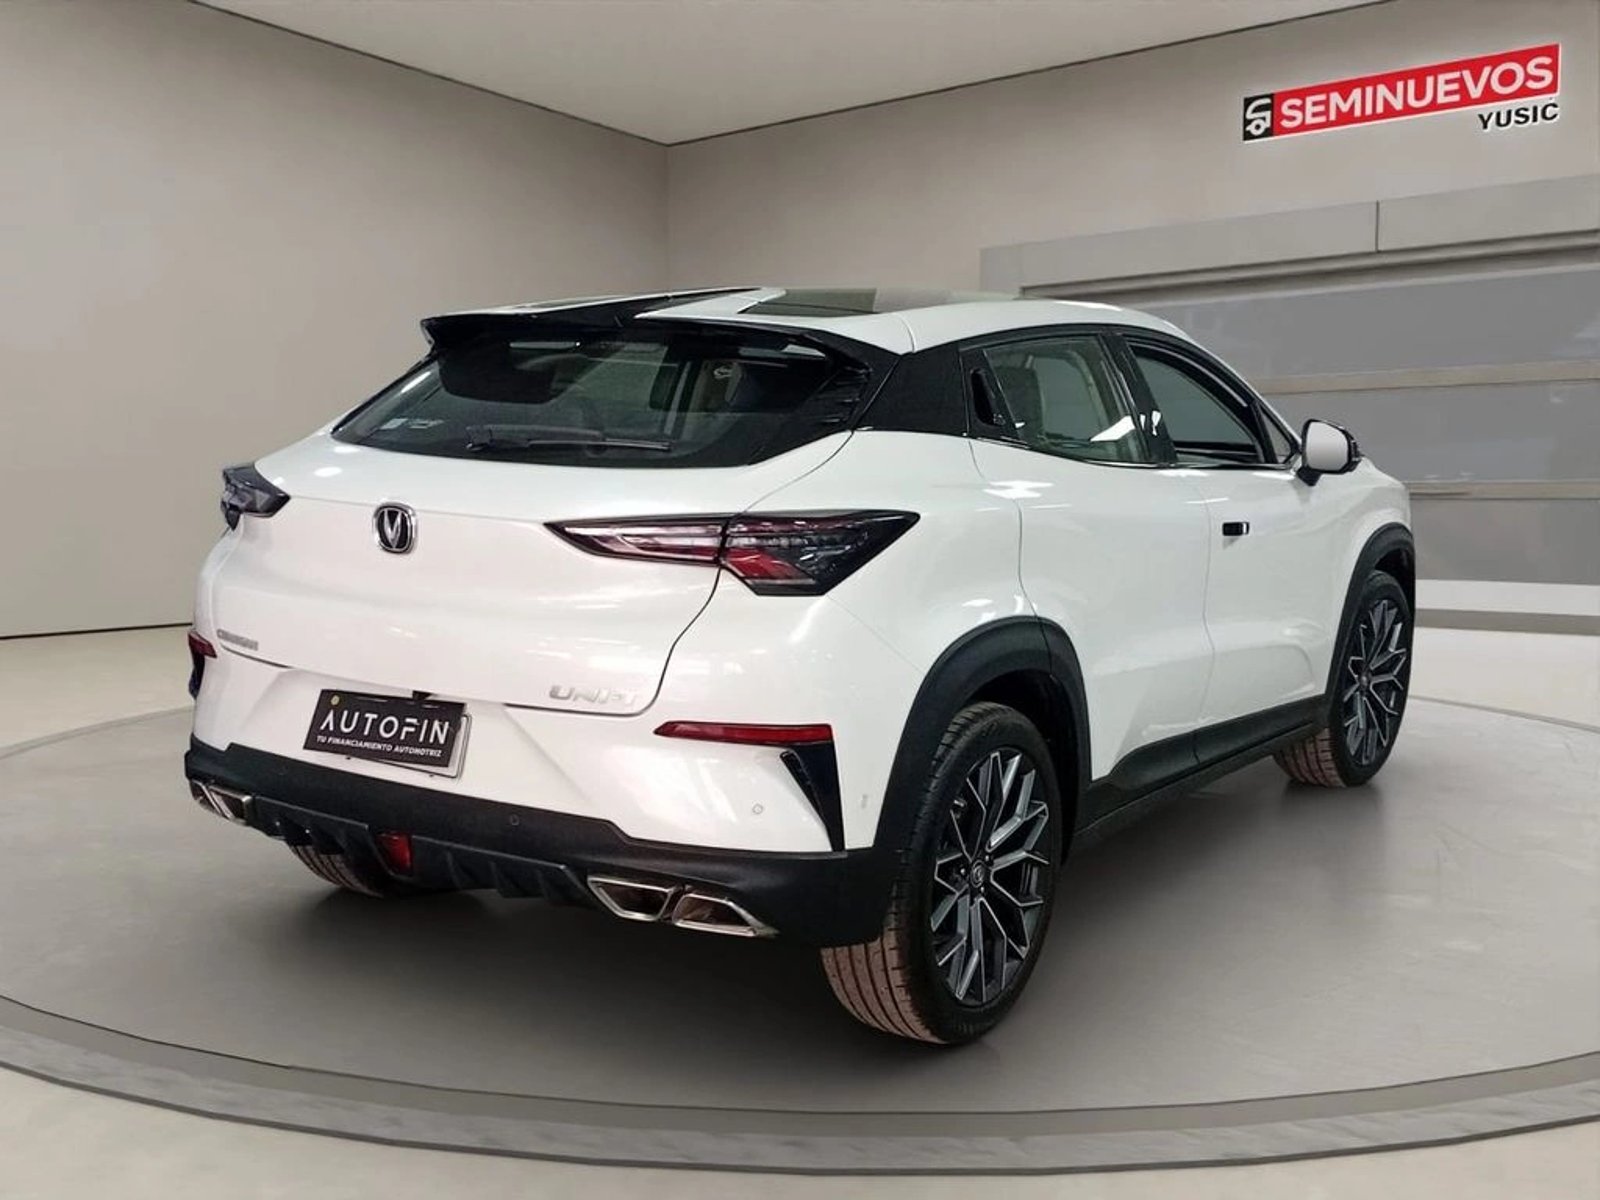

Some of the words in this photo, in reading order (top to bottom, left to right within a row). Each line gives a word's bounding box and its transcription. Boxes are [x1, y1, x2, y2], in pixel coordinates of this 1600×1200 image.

[1280, 56, 1553, 128] SEMINUEVOS
[320, 709, 450, 745] AUTOFIN
[316, 735, 328, 744] TU
[327, 736, 393, 752] FINANCIAMIENTO
[393, 744, 443, 758] AUTOMOTRIZ
